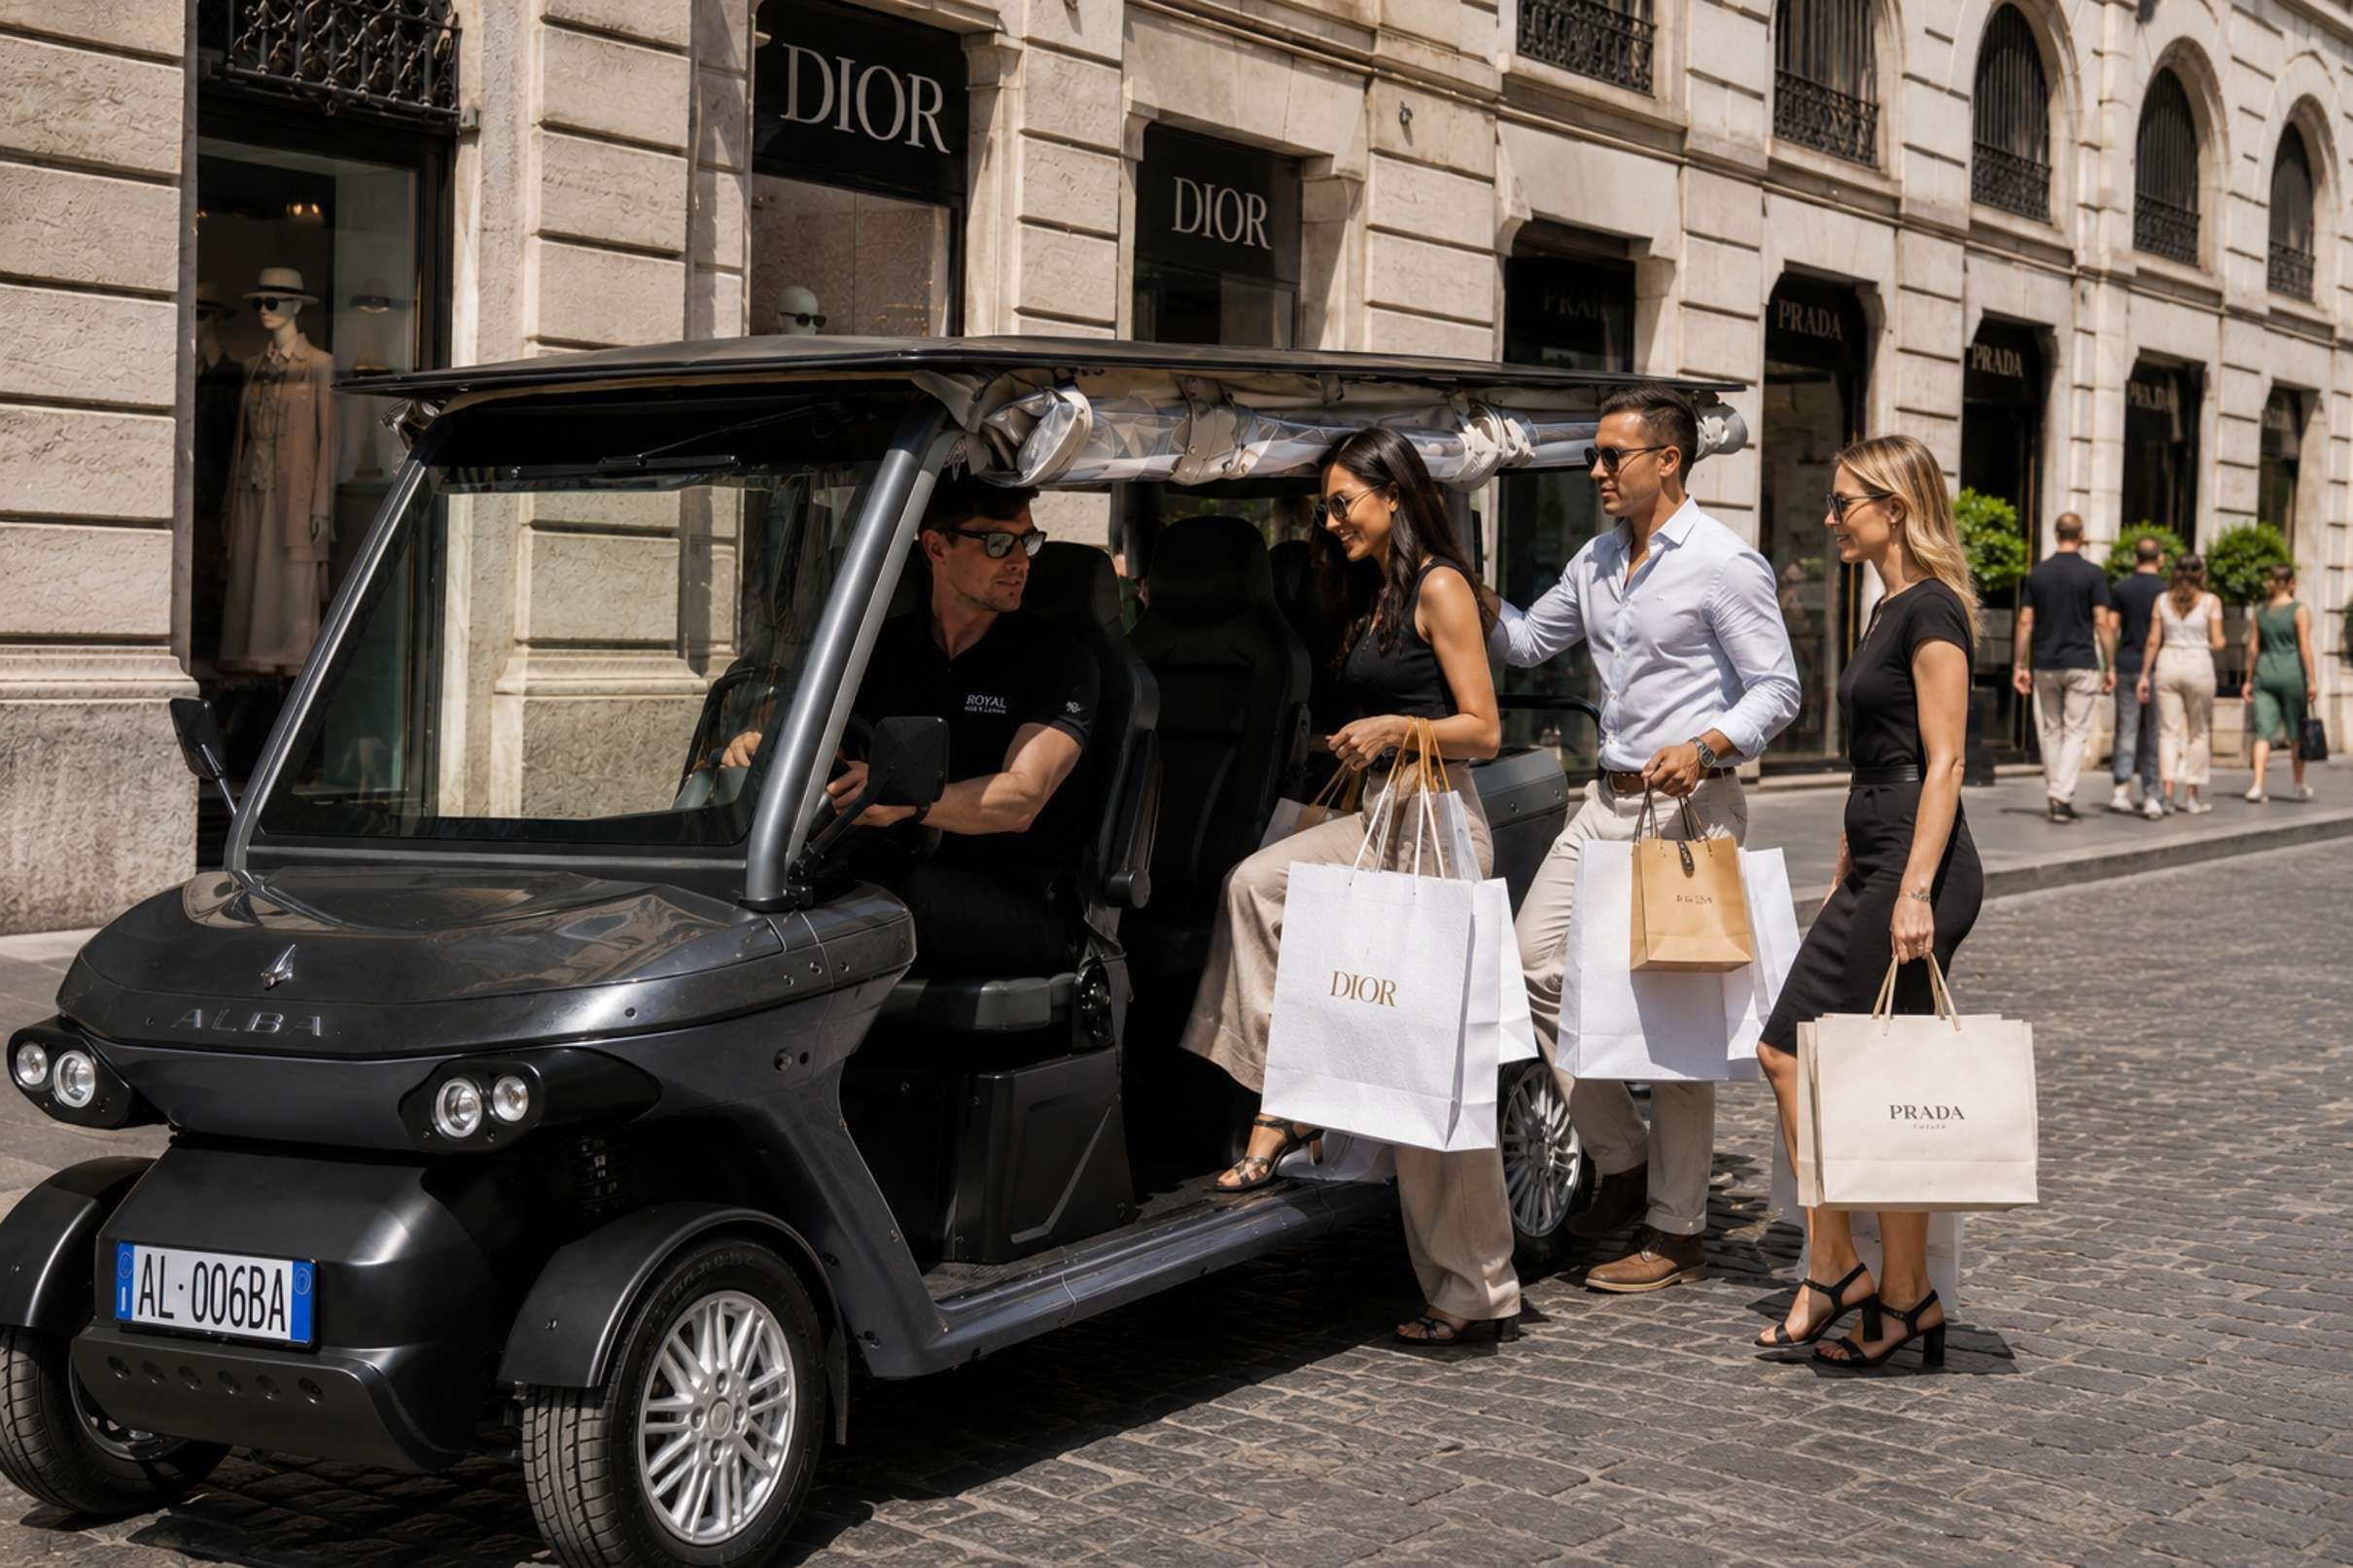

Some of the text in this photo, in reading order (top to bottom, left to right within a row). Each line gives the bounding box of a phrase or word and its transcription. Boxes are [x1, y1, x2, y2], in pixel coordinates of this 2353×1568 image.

[780, 43, 951, 155] DIOR
[1171, 176, 1273, 250] DIOR
[1777, 299, 1843, 341] PRADA
[1972, 343, 2022, 378] PRADA
[966, 694, 1006, 708] ROYAL
[1330, 970, 1396, 1006] DIOR
[171, 1008, 321, 1036] ALBA
[1889, 1104, 1965, 1120] PRADA
